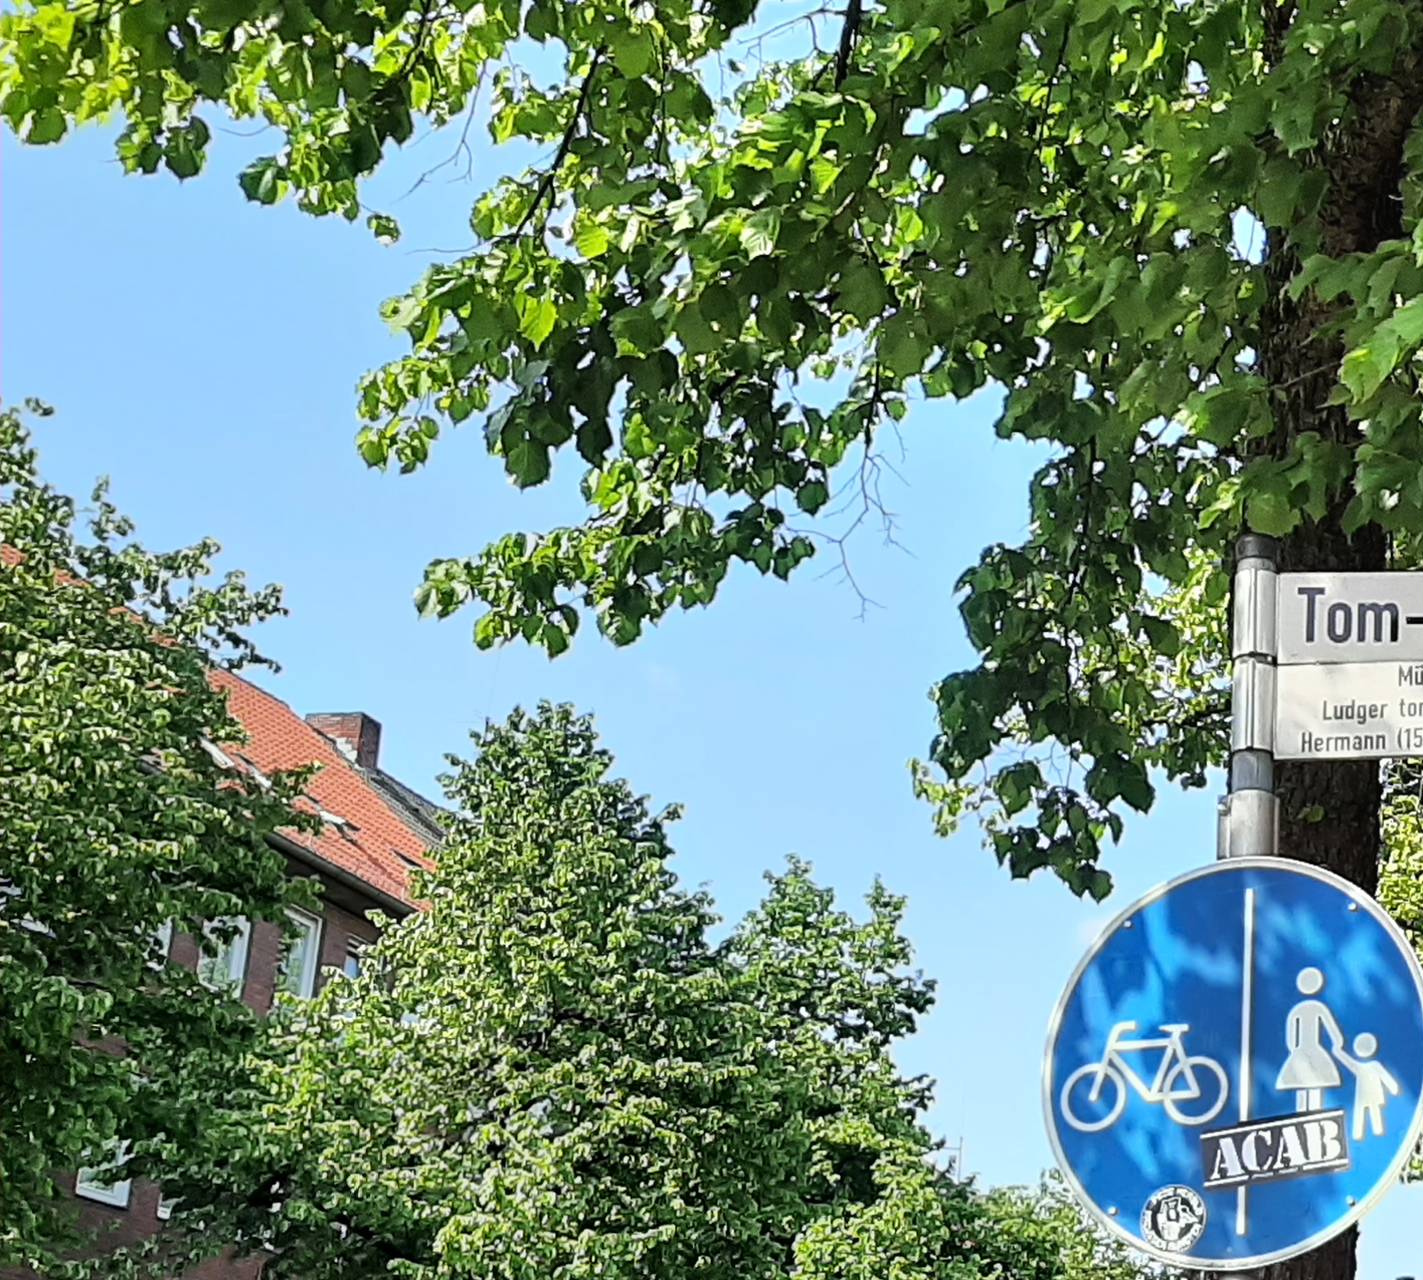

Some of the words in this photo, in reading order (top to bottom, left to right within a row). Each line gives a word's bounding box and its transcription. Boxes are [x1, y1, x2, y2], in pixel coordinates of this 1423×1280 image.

[1323, 699, 1388, 724] Ludger
[1301, 732, 1386, 752] Hermann
[1210, 1119, 1342, 1180] ACAB
